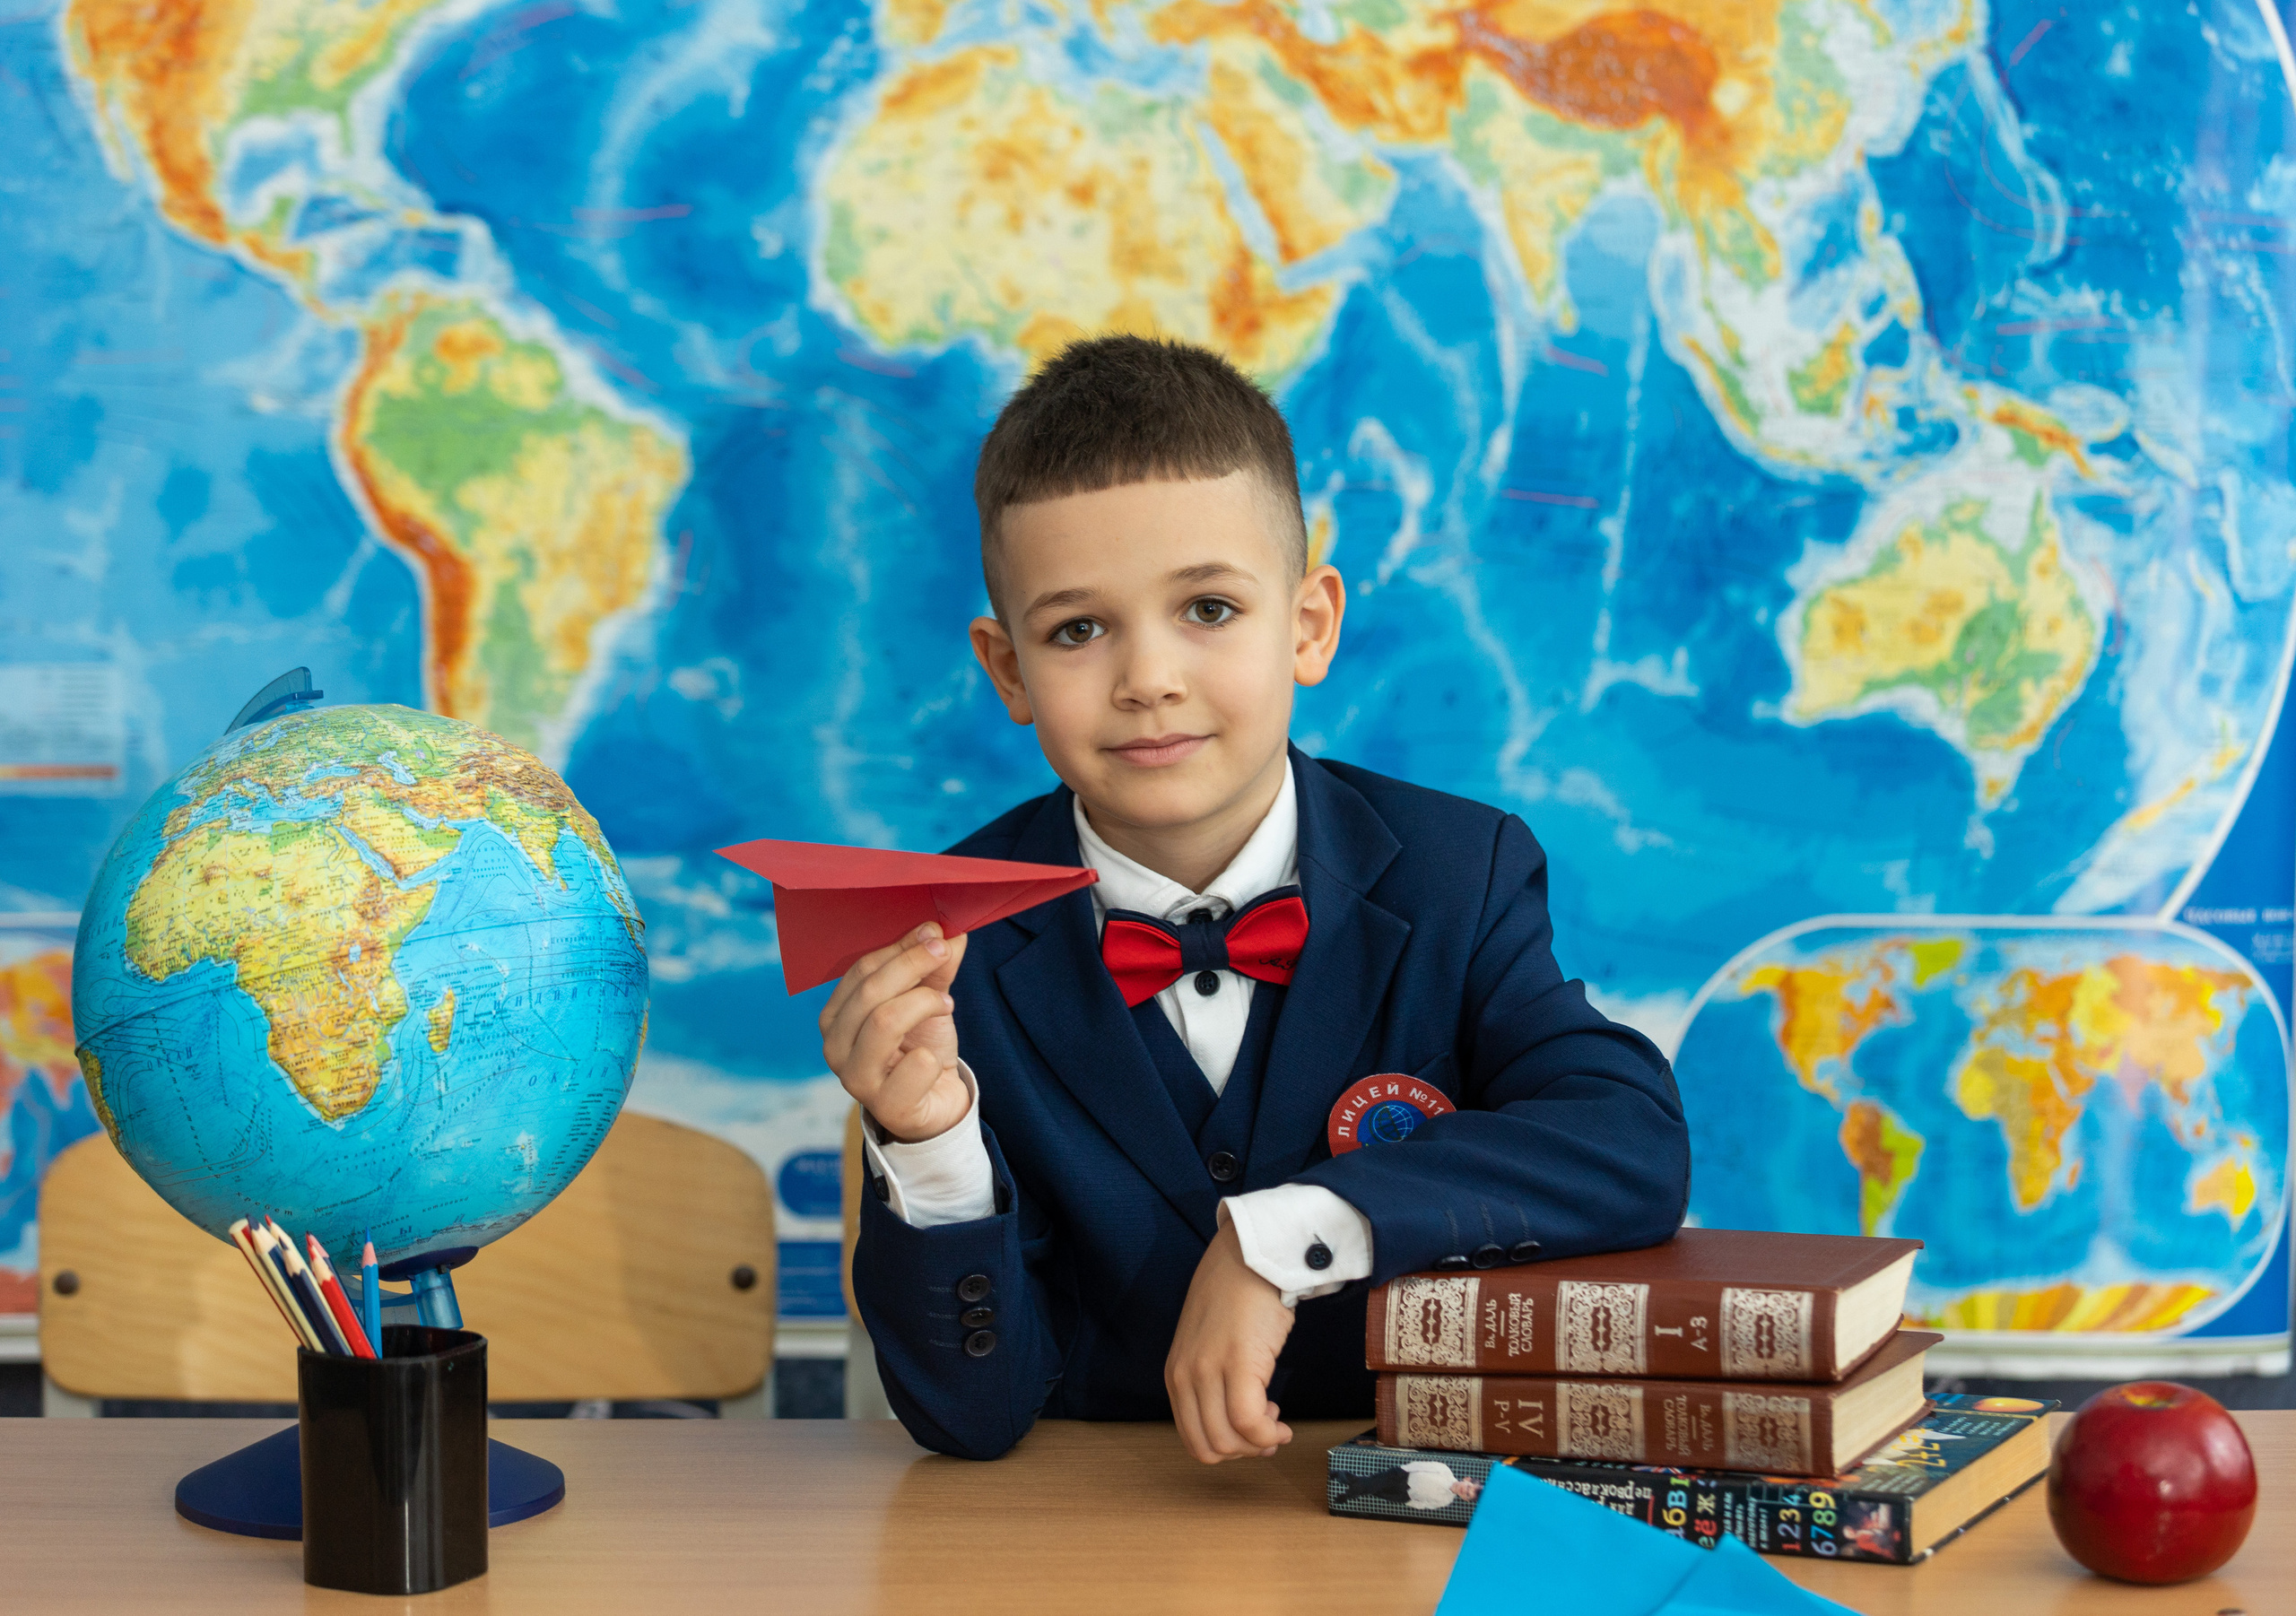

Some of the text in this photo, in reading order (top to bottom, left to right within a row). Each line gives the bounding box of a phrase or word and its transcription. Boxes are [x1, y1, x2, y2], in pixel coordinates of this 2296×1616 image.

[1337, 1081, 1400, 1138] ЛИЦЕЙ
[1484, 1299, 1498, 1333] ДАЛЬ
[1507, 1292, 1522, 1357] ТОЛКОВЫЙ
[1521, 1298, 1535, 1352] СЛОВАРЬ
[1518, 1399, 1544, 1438] IV
[1664, 1399, 1677, 1451] СЛОВАРЬ
[1675, 1394, 1693, 1456] ТОЛКОВЫЙ
